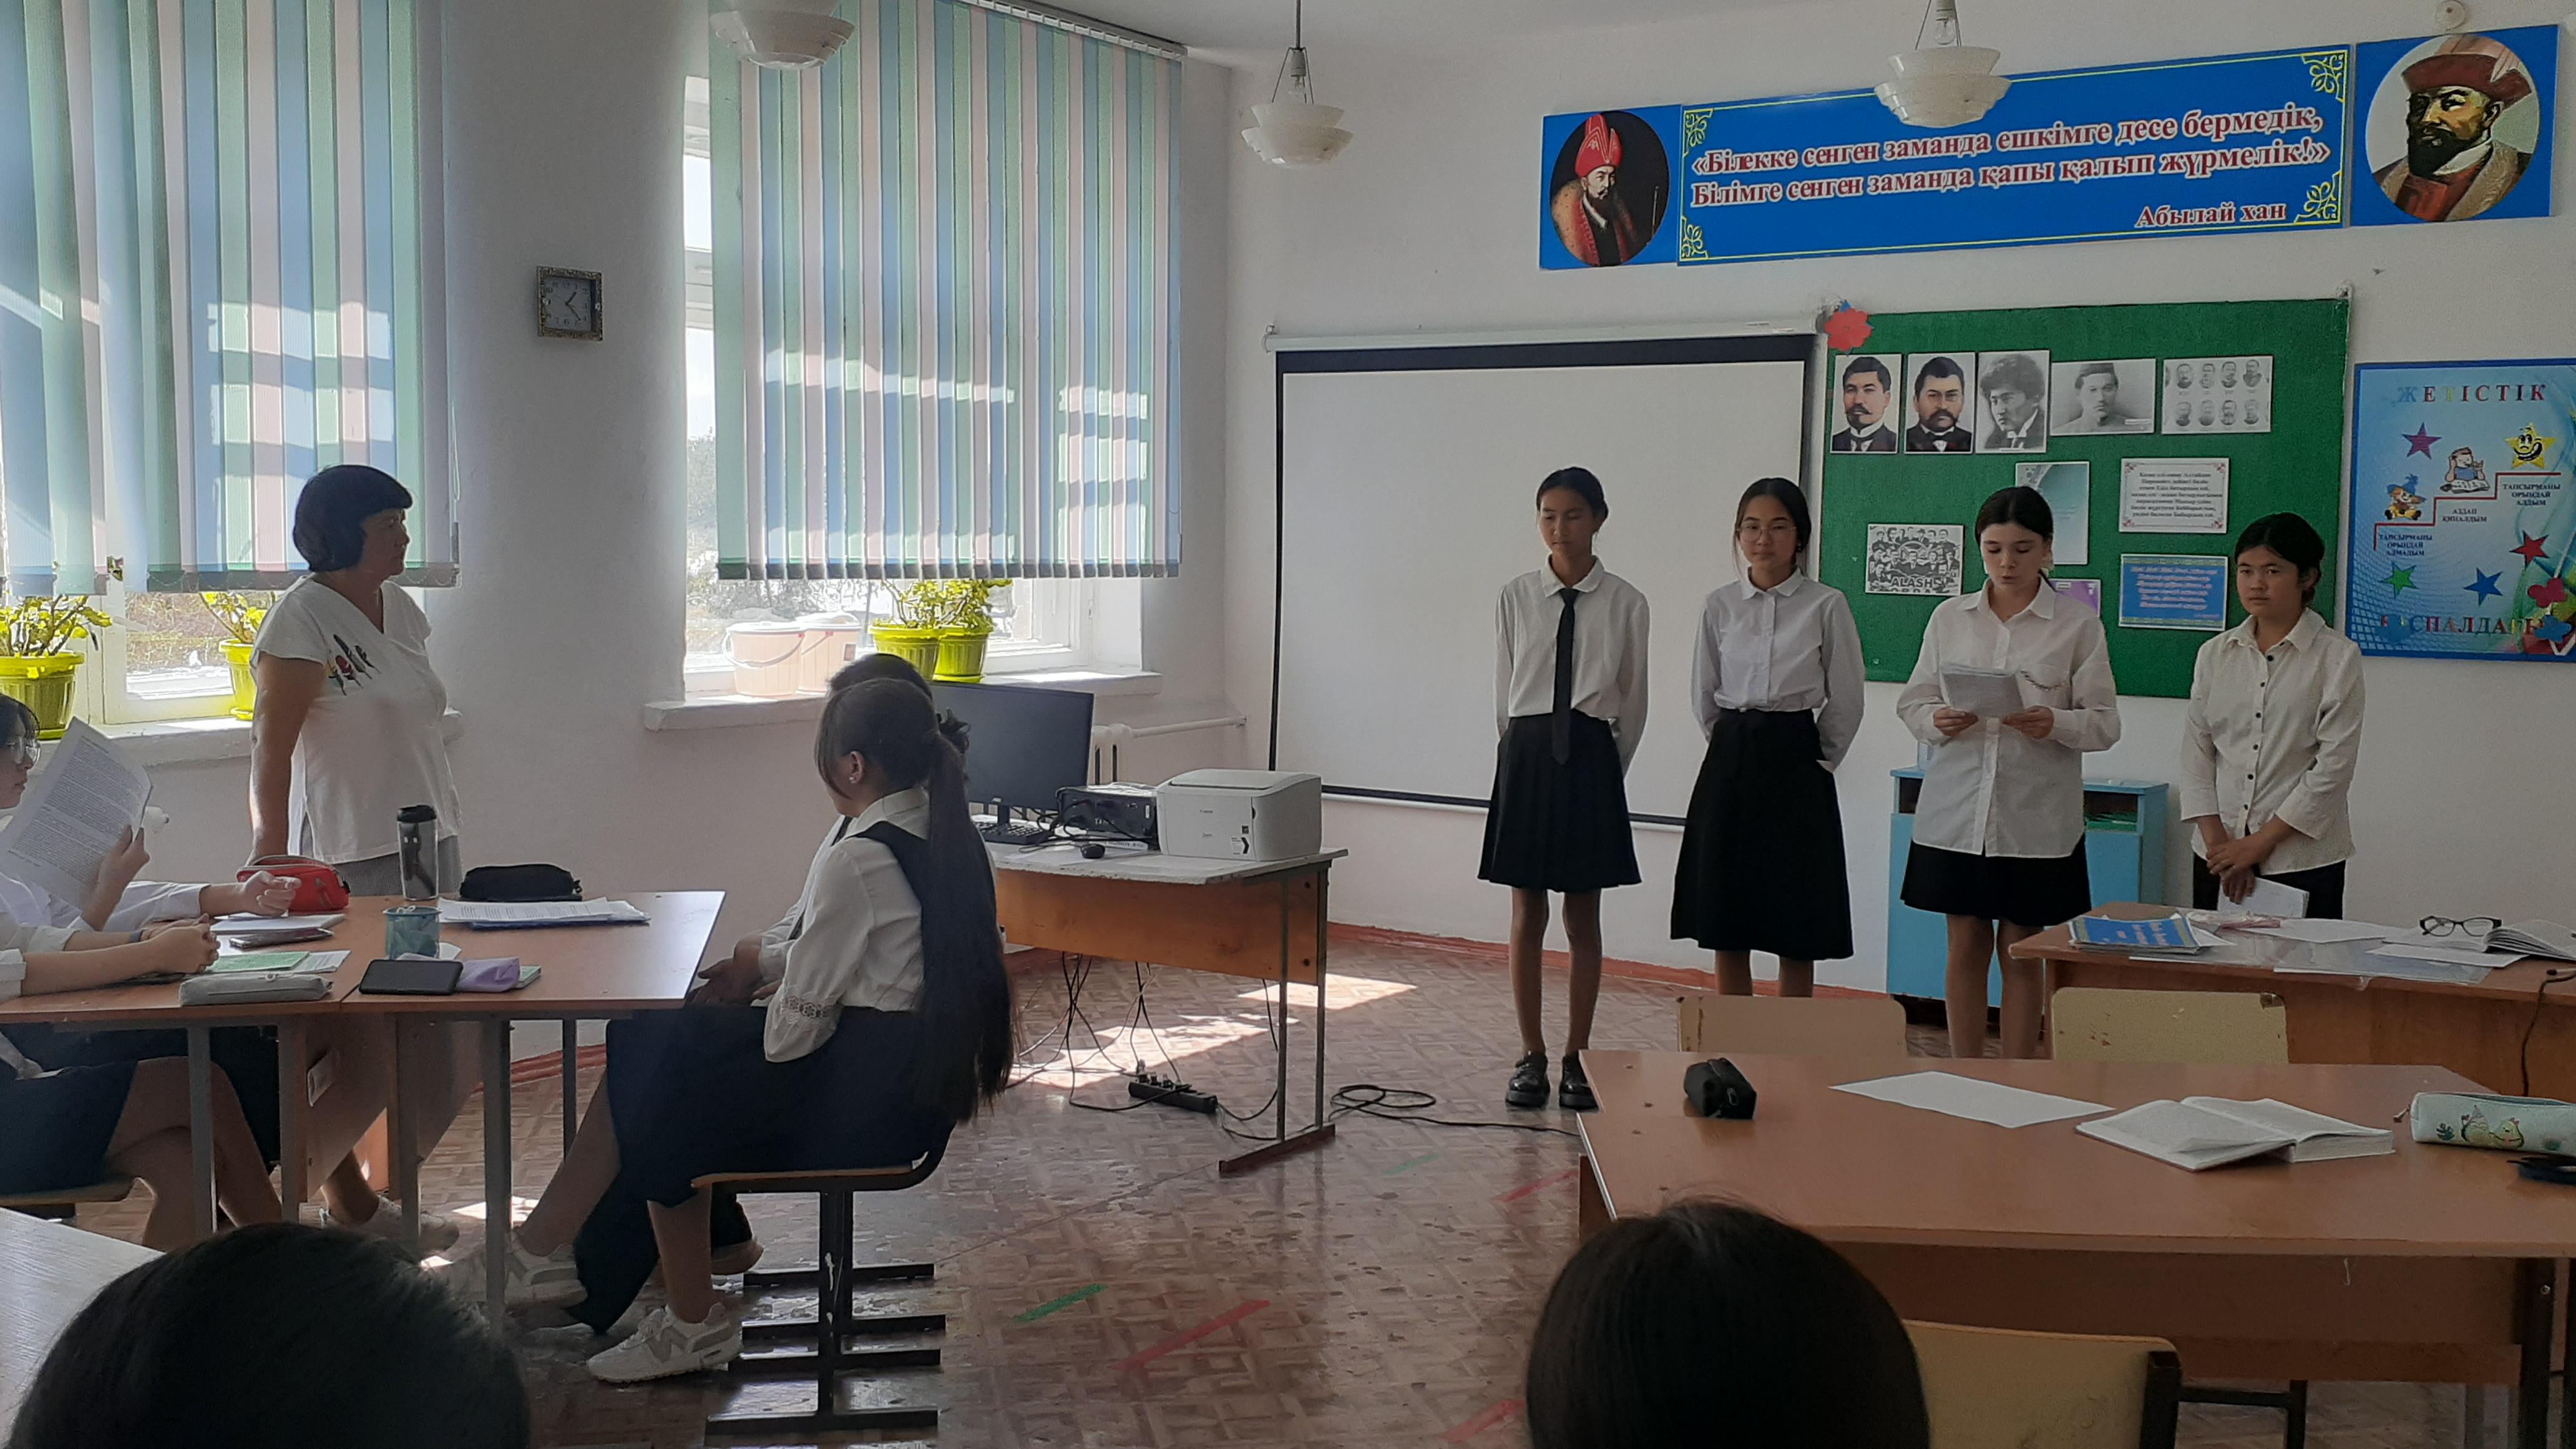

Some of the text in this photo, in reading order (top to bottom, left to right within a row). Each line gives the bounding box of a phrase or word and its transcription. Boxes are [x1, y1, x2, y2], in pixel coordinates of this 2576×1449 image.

[1693, 102, 2324, 174] «Білекке сенген заманда ешкімге десе бермедік,
[1691, 136, 2331, 207] Білімге сенген заманда қапы қалып жүрмелік!»
[2134, 201, 2287, 227] Абылай хан
[2397, 384, 2547, 402] ЖЕТІСТІК
[1891, 577, 1933, 588] ALASH
